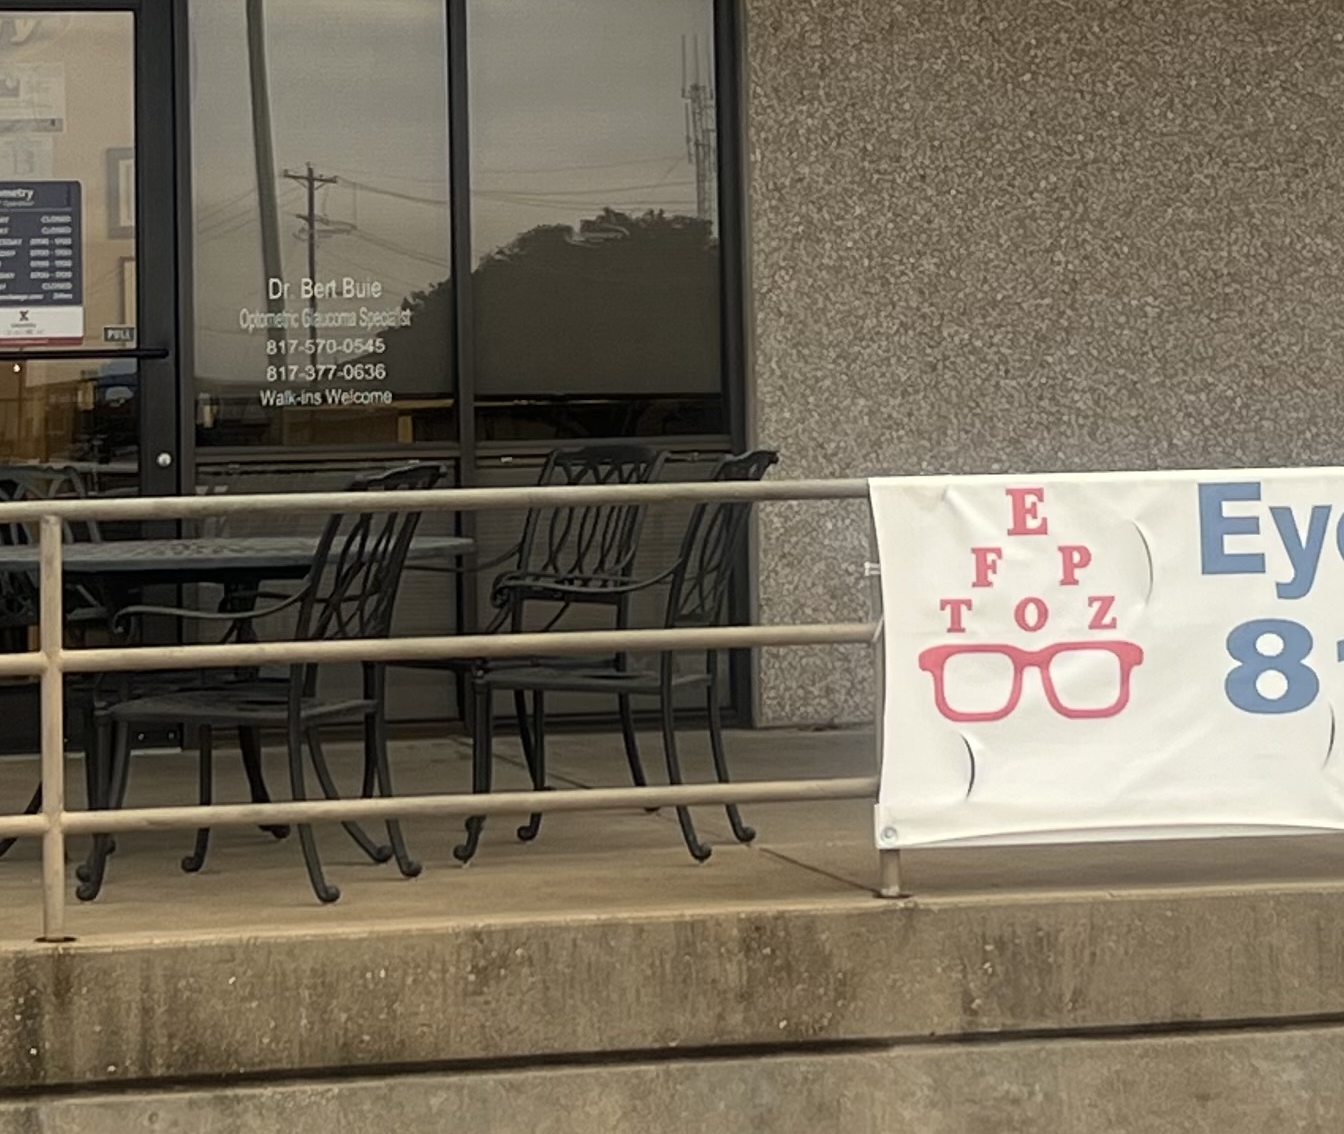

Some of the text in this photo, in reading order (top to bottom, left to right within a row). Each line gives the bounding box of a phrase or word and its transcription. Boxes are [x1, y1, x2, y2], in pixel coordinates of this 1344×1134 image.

[301, 277, 337, 298] Bert
[342, 277, 382, 298] Buie
[239, 306, 412, 333] Optometric Glaucoma Specialist
[266, 338, 386, 355] 817-570-0545
[266, 364, 387, 381] 817-377-0636
[260, 388, 393, 406] Walk-ins Welcome
[1005, 487, 1048, 536] E
[971, 545, 1092, 587] F P
[939, 596, 1118, 633] T O Z
